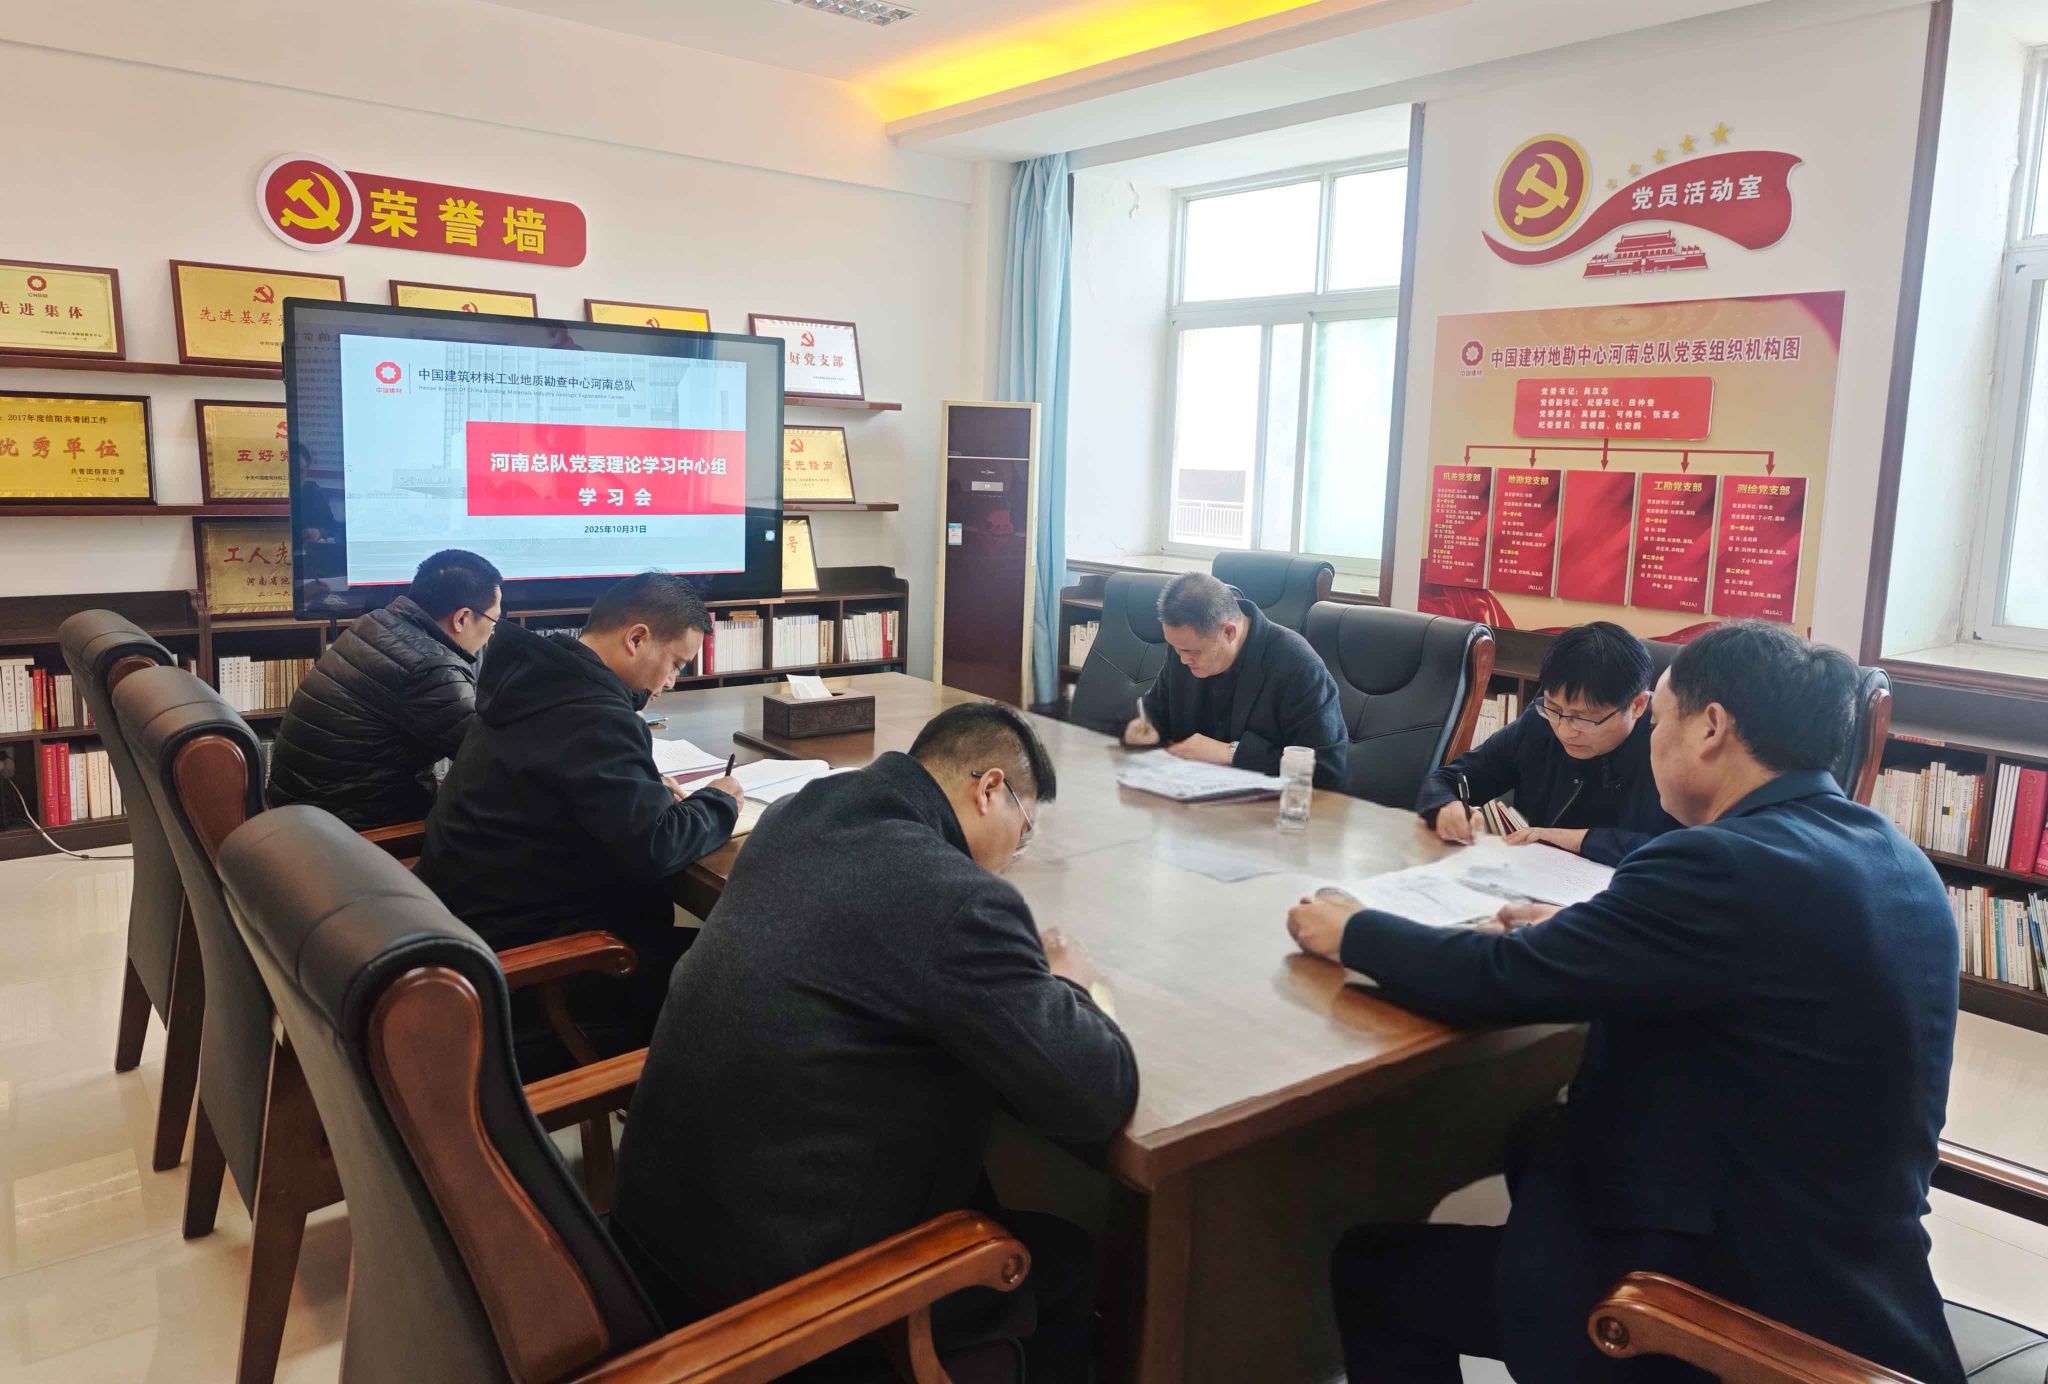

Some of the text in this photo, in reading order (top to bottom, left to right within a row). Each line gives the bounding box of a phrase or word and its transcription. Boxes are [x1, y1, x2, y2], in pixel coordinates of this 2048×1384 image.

[1632, 175, 1763, 211] 党员活动室
[370, 188, 547, 254] 荣誉墙
[785, 351, 844, 367] 好党支部
[1491, 336, 1801, 369] 中国建材地勘中心河南总队党委组织机构图
[419, 368, 635, 391] 中国建筑材料工业地质勘查中心河南总队
[0, 437, 119, 459] 优秀单位
[490, 453, 727, 475] 河南总队党委理论学习中心组
[1443, 472, 1481, 482] 机关党支部
[1654, 481, 1702, 492] 工勘党支部
[578, 488, 652, 507] 学习会
[1737, 484, 1790, 496] 测绘党支部
[584, 525, 647, 534] 2025年10月31日
[224, 541, 291, 566] 工人先
